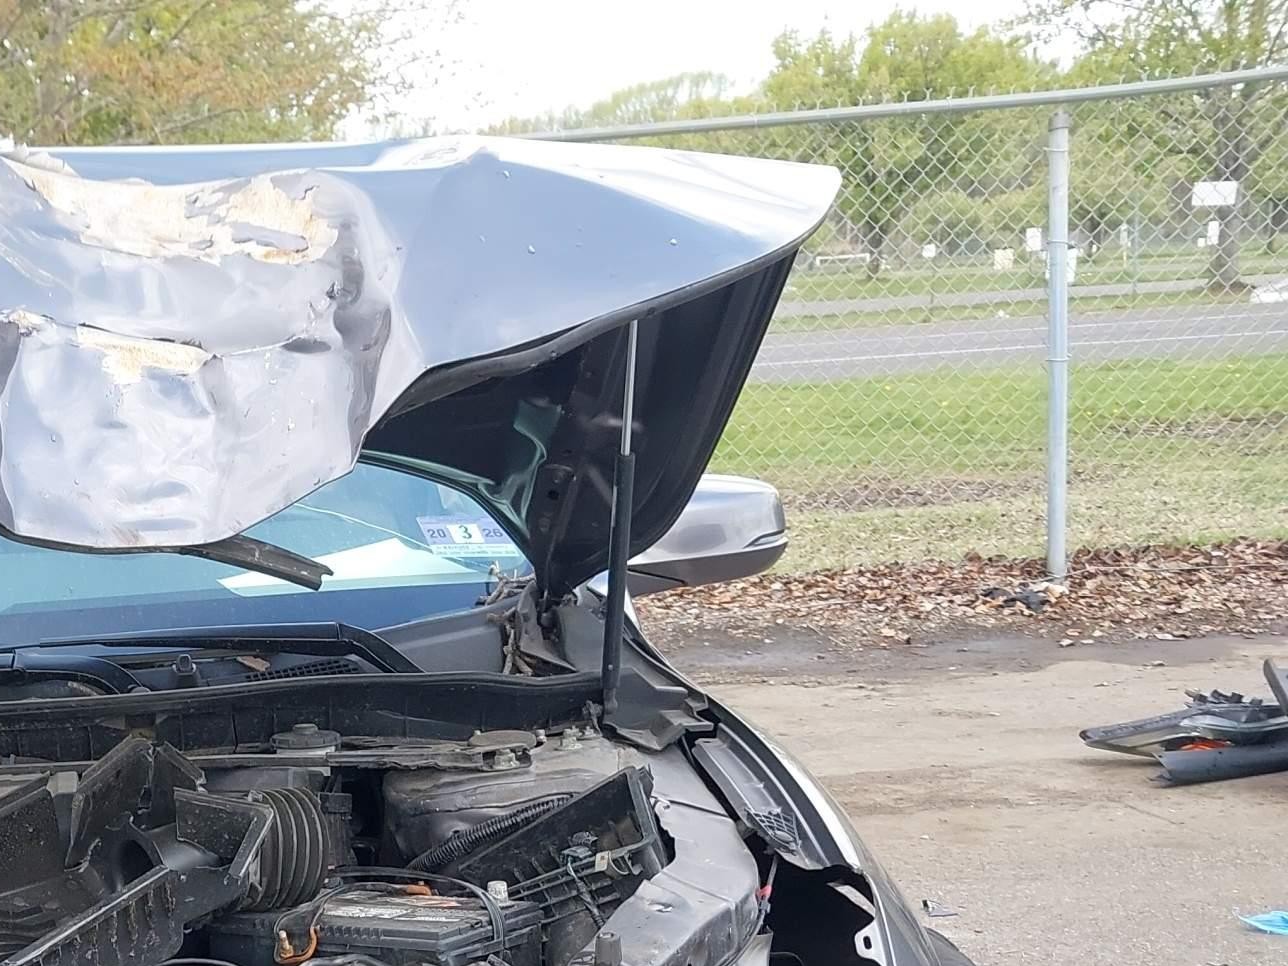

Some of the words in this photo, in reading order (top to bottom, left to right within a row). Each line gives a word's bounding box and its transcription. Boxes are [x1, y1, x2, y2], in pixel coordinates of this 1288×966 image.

[427, 528, 447, 539] 20
[458, 524, 473, 540] 3
[482, 528, 503, 538] 26
